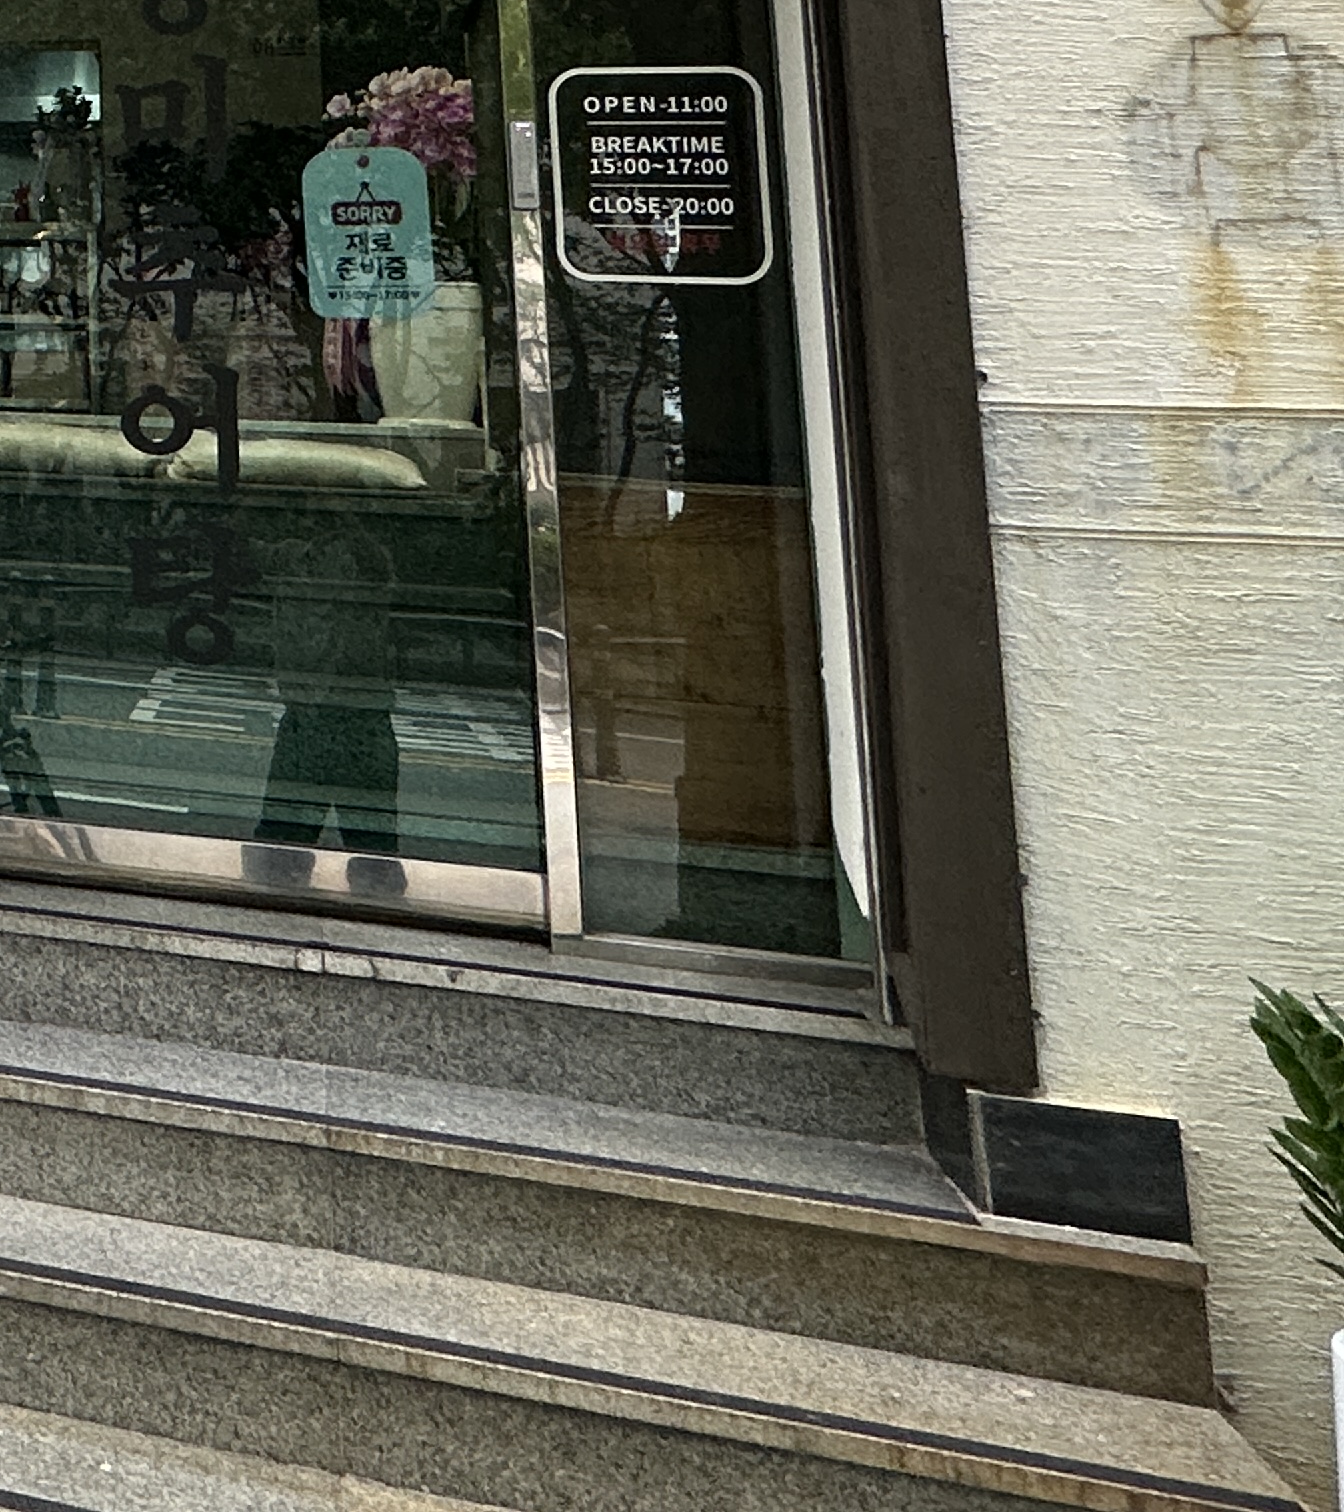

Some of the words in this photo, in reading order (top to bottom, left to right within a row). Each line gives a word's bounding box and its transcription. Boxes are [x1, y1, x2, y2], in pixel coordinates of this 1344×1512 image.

[590, 136, 725, 154] BREAKTIME
[589, 158, 729, 175] 15:00~17:00
[336, 206, 397, 221] SORRY
[345, 232, 395, 255] 재료
[336, 256, 408, 281] 준비중
